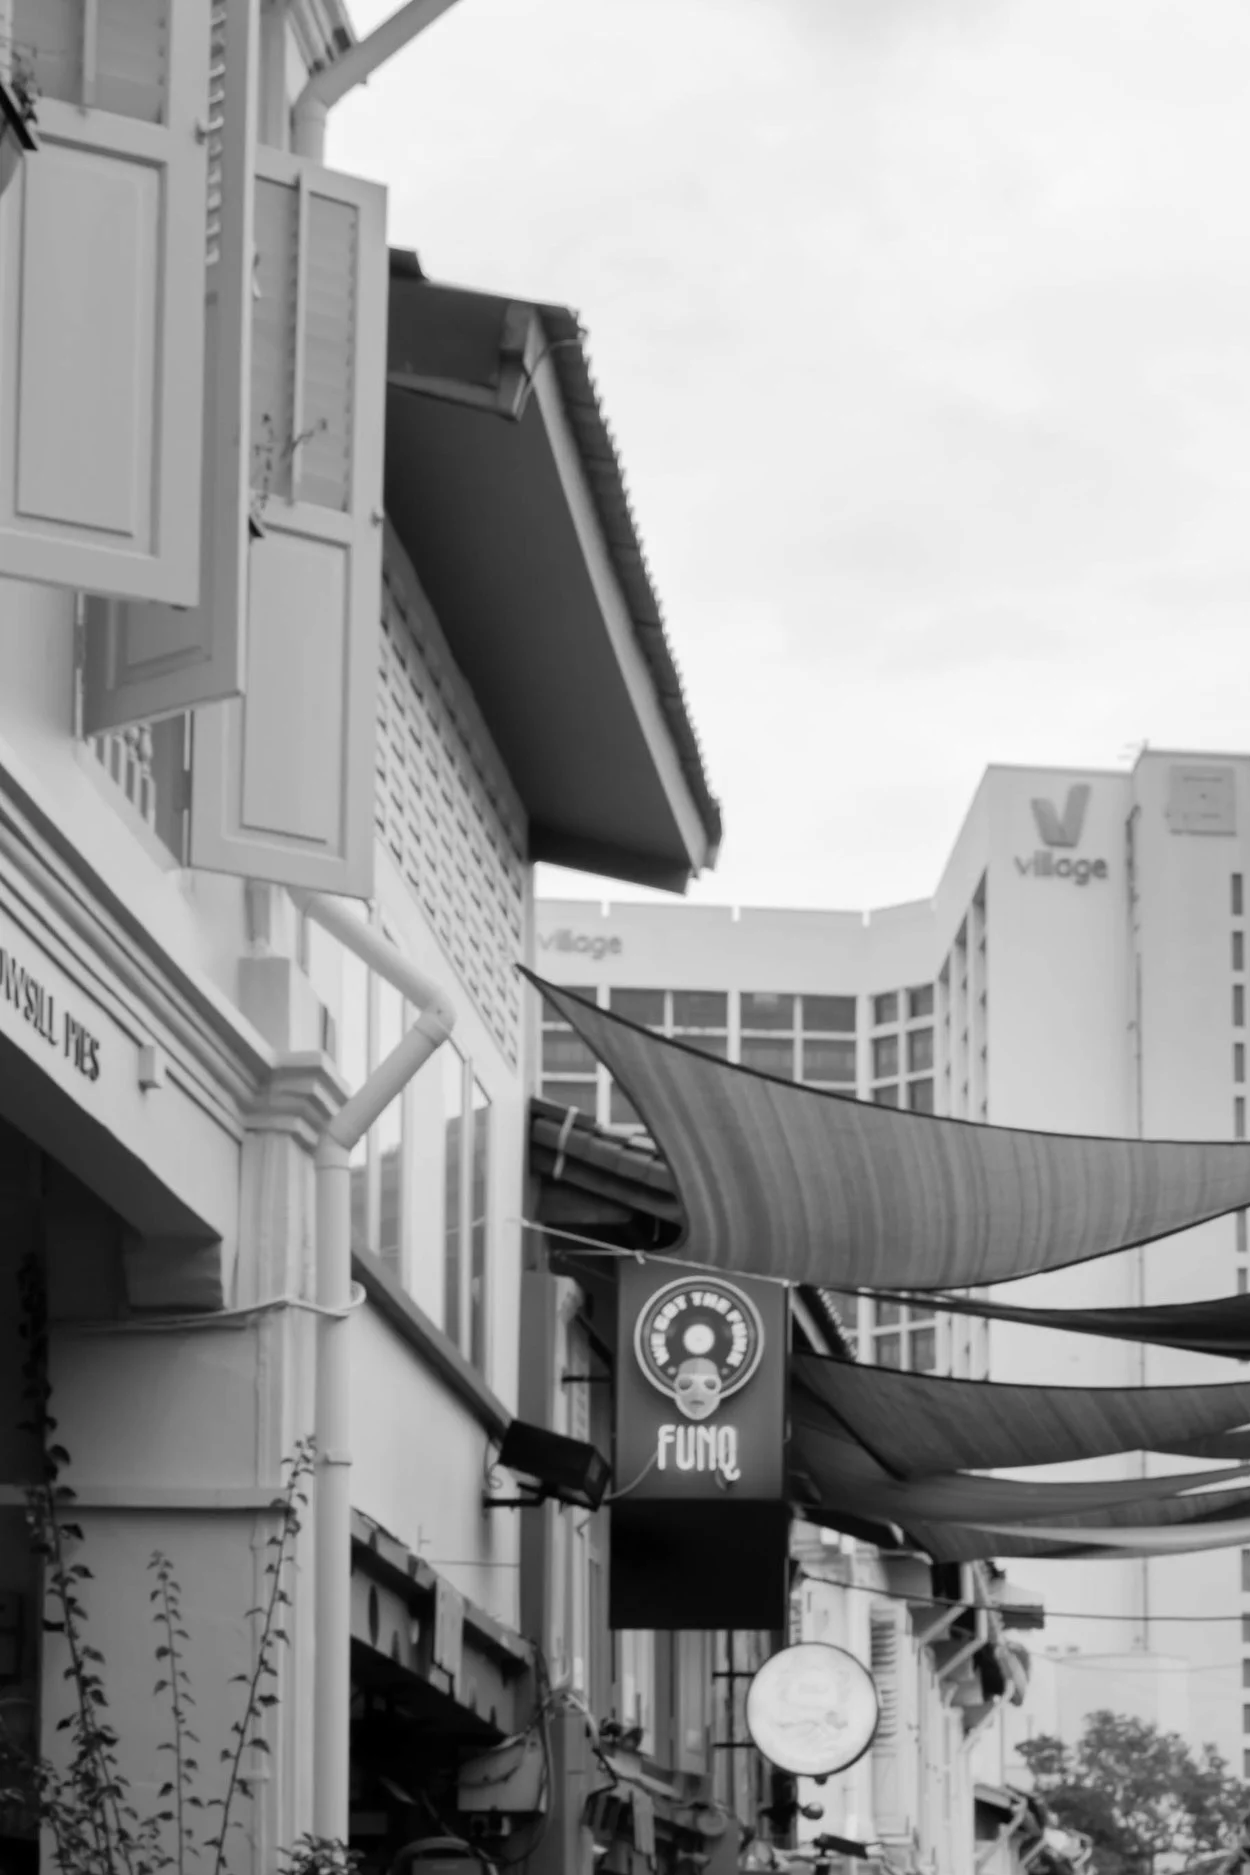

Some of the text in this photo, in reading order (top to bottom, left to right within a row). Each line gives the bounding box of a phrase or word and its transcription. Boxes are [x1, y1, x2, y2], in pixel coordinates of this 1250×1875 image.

[1013, 850, 1108, 887] village
[65, 1012, 99, 1081] PIES
[690, 1291, 732, 1315] THE
[657, 1424, 741, 1481] FUNQ
